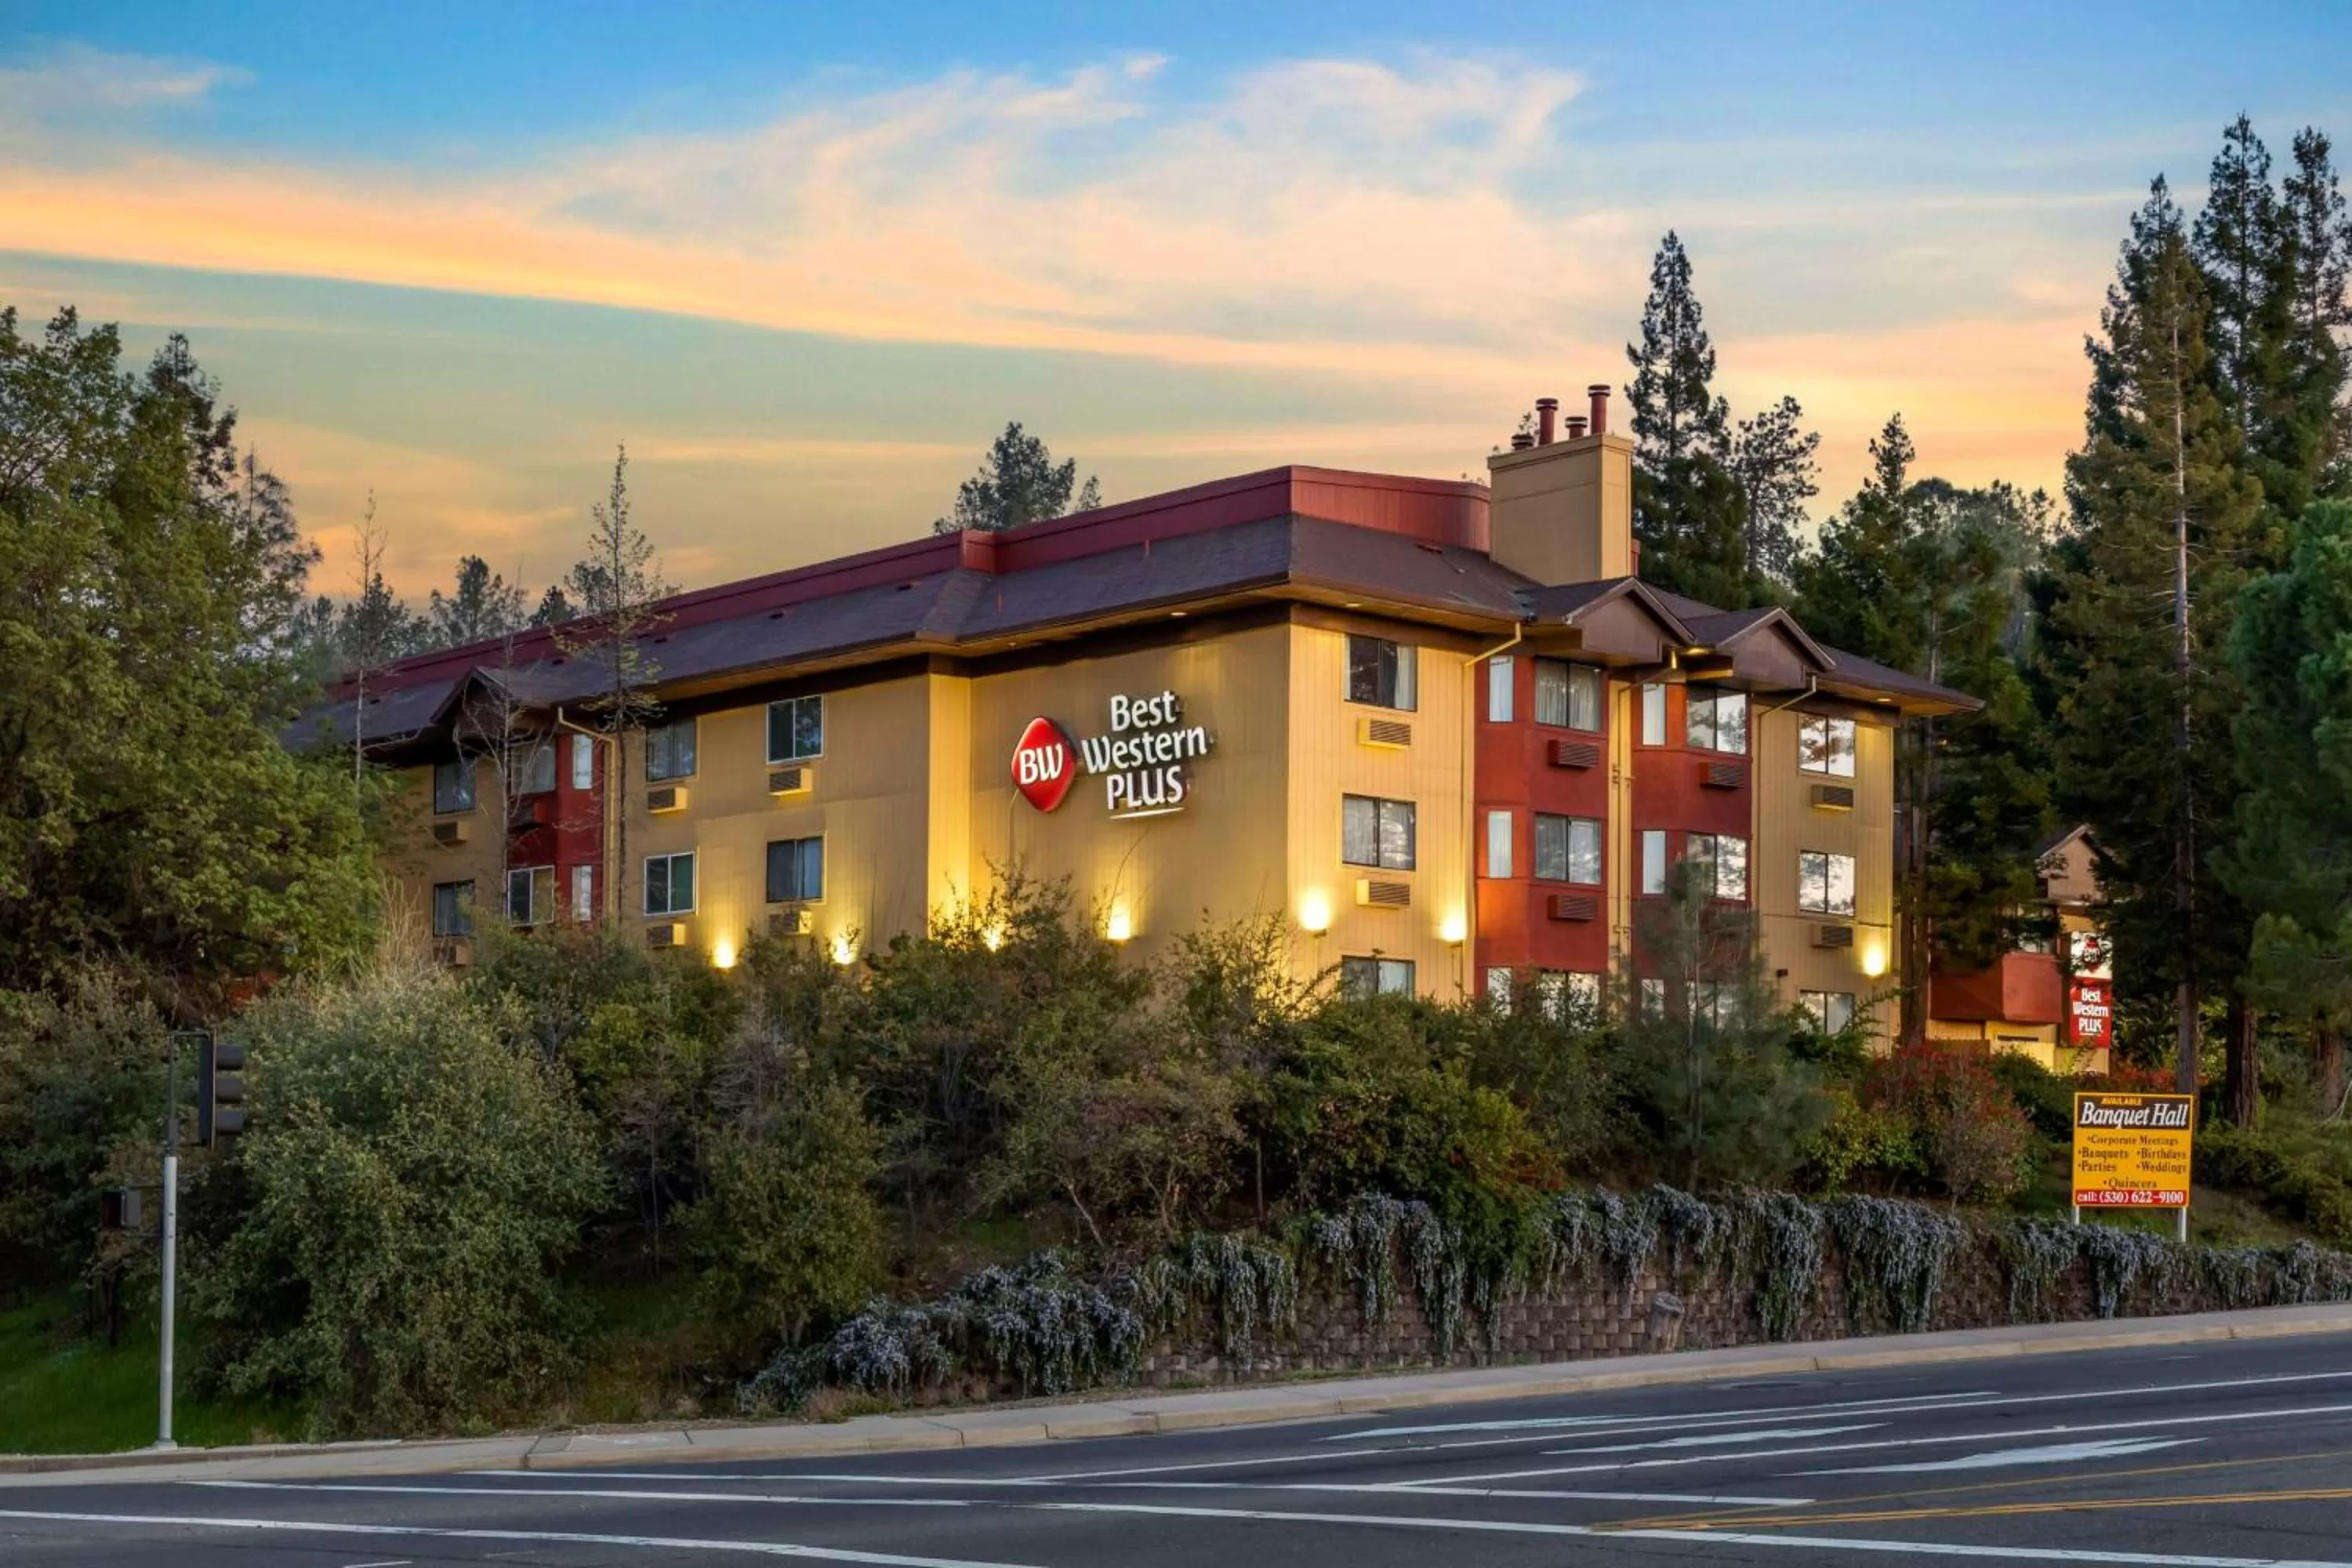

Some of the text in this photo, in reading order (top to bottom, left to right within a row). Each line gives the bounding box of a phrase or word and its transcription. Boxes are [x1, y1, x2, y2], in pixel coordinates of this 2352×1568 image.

[1110, 690, 1176, 731] Best
[1081, 726, 1207, 775] Western
[1019, 743, 1063, 785] BW
[1106, 765, 1183, 810] PLUS
[2082, 988, 2101, 1002] Best
[2072, 1001, 2108, 1017] Western
[2080, 1102, 2188, 1129] Banquet Hall
[2090, 1135, 2179, 1146] Corporate Meetings
[2082, 1147, 2186, 1161] Banquets Birthdays
[2082, 1160, 2187, 1174] Parties Weddings
[2078, 1191, 2183, 1203] call: (530) 622-9100
